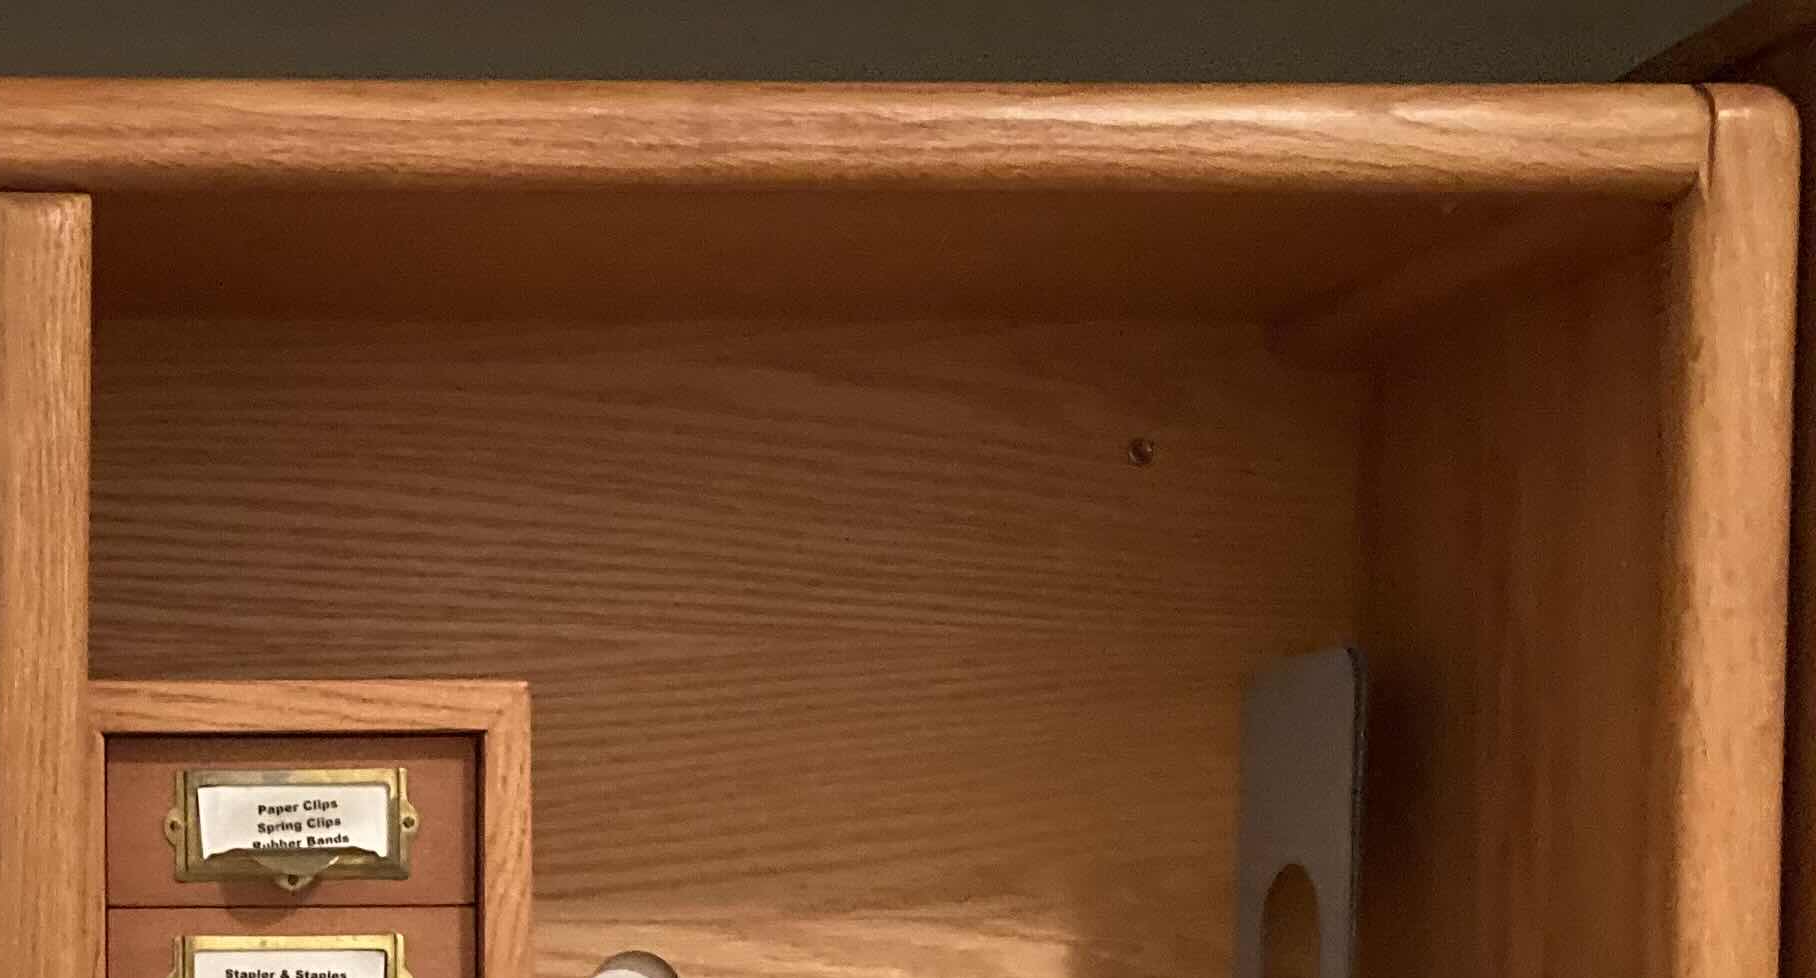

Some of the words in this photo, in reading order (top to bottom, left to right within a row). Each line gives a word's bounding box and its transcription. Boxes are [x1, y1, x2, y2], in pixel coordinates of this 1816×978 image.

[258, 802, 299, 816] Paper
[303, 799, 338, 813] Clips
[257, 820, 302, 834] Spring
[307, 816, 341, 830] Clips
[307, 834, 350, 847] Bands
